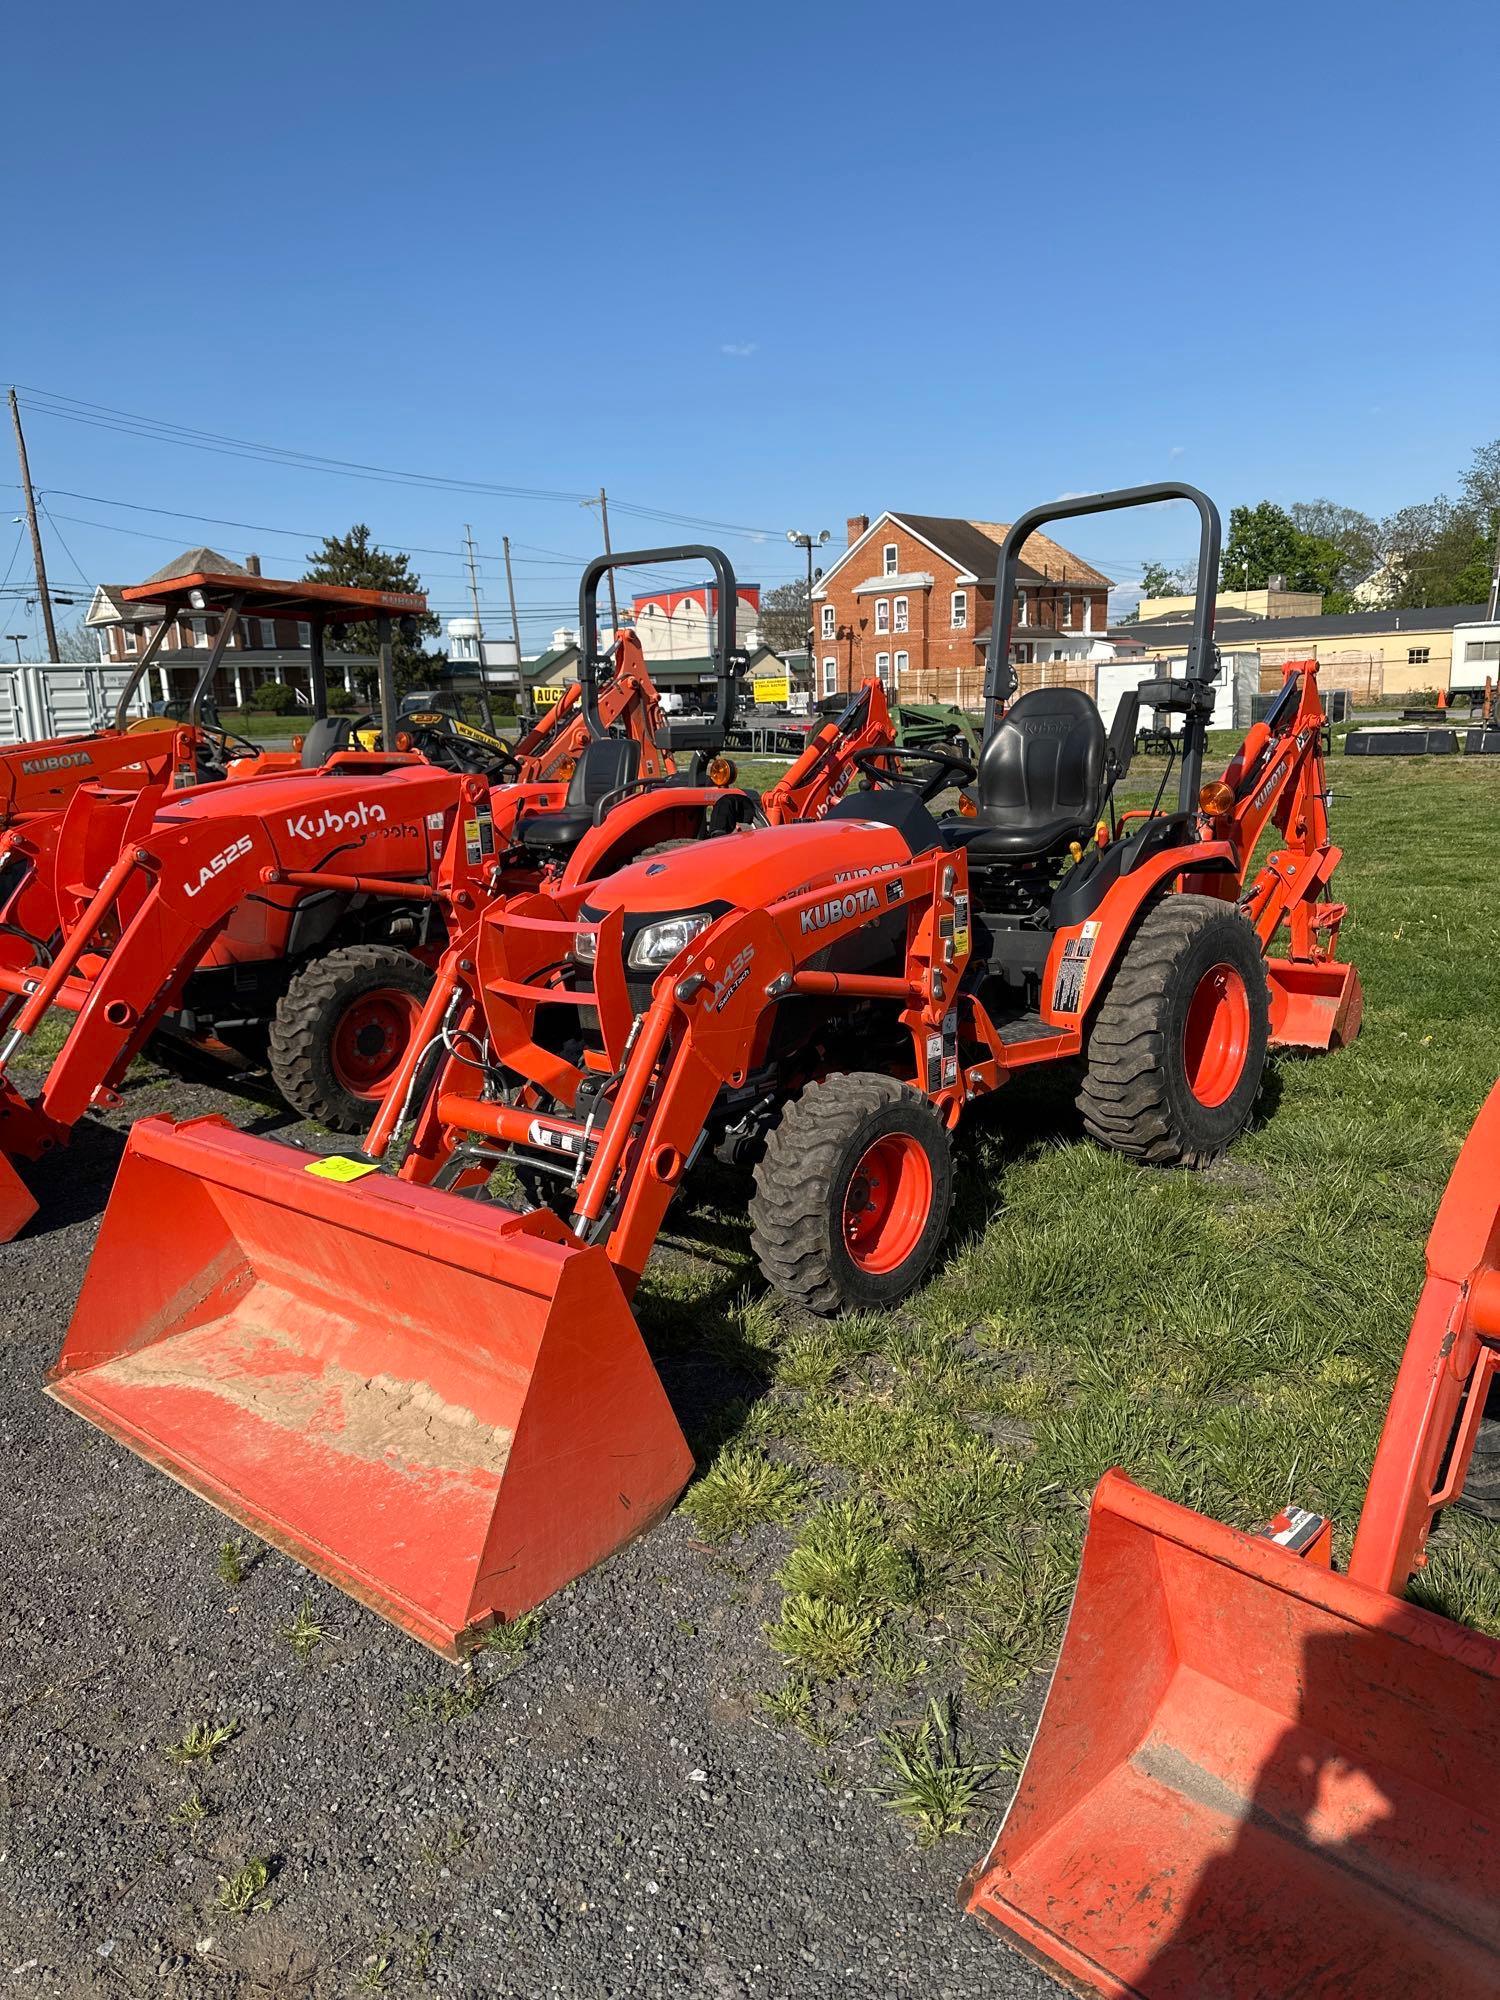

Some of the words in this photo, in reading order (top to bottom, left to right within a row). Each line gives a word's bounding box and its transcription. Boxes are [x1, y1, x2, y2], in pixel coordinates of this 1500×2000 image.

[537, 690, 564, 702] AUC
[21, 751, 93, 775] KUBOTA
[1254, 760, 1288, 811] KUBOTA
[286, 801, 387, 840] Kubota
[183, 834, 253, 897] LA525
[800, 887, 880, 935] KUBOTA
[703, 942, 755, 1013] LA435
